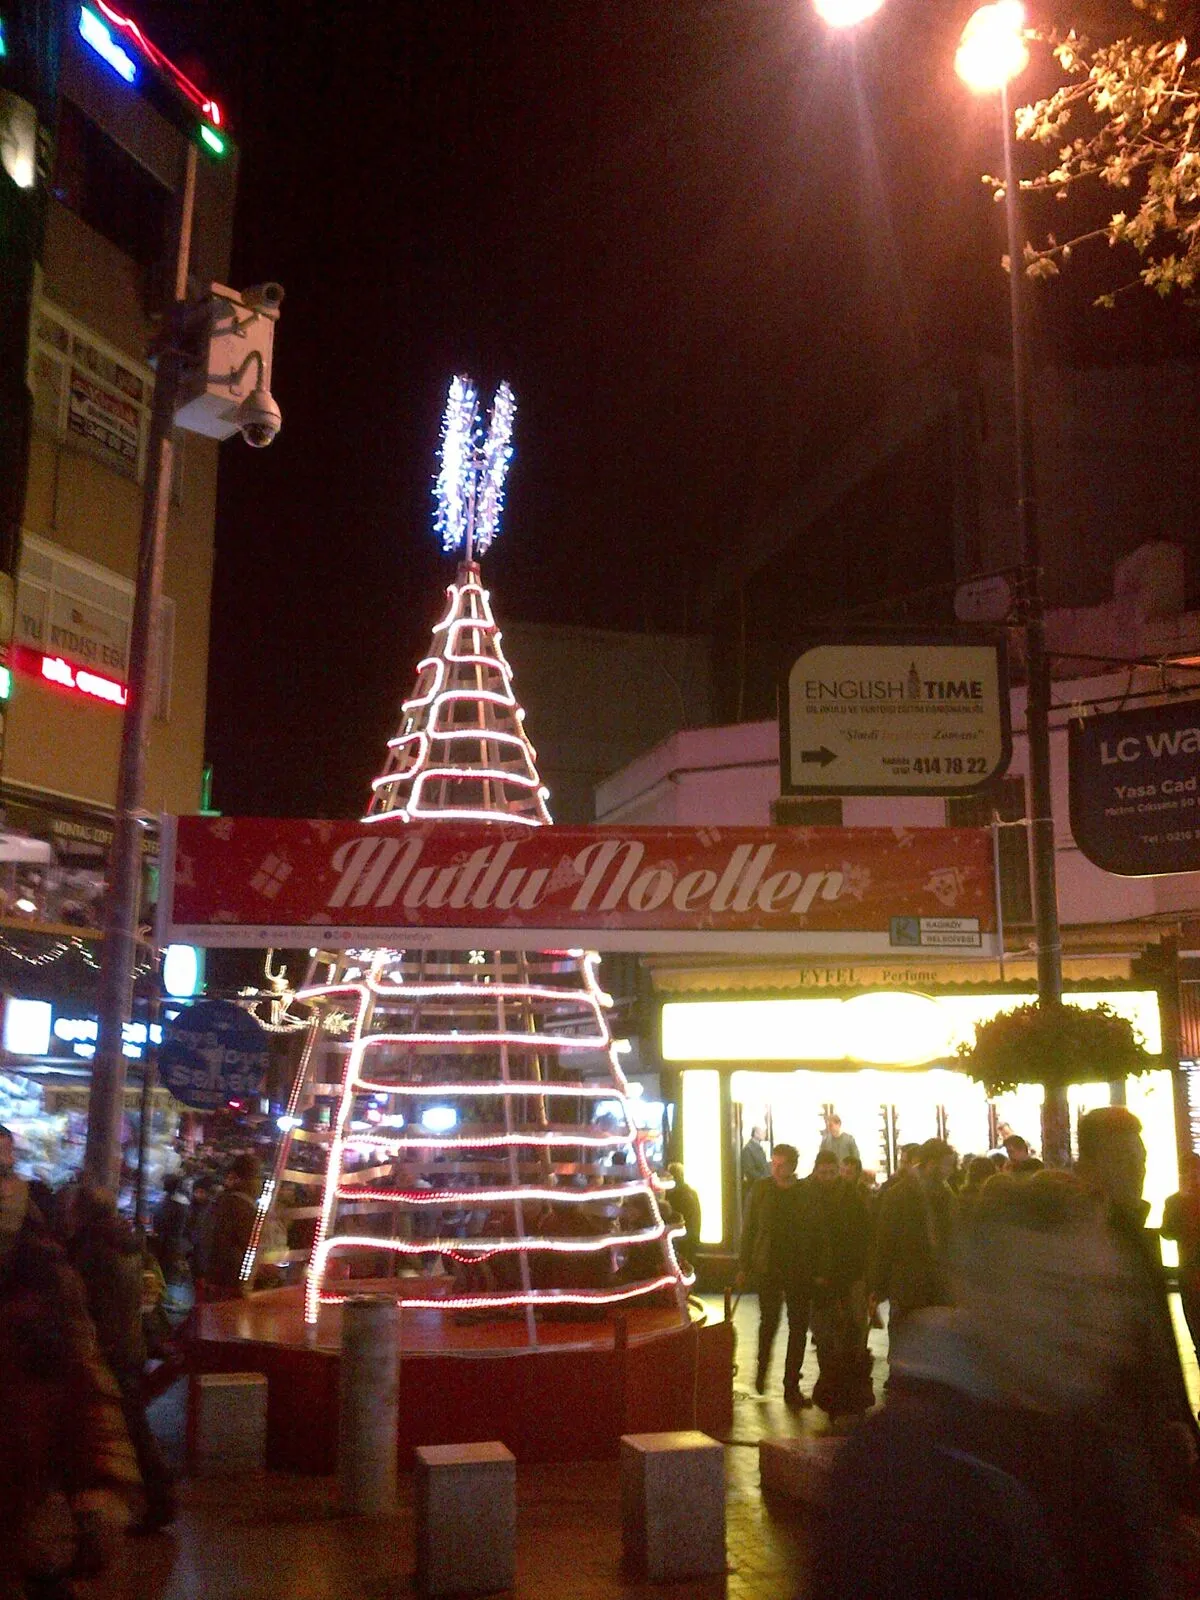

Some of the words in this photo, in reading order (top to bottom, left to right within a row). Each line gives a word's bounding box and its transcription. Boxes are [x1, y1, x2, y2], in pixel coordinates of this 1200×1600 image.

[805, 680, 904, 699] ENGLISH
[924, 681, 983, 699] TIME
[1100, 736, 1141, 765] LC
[913, 757, 941, 774] 414
[945, 757, 963, 774] 78
[967, 757, 987, 774] 22
[1114, 785, 1157, 799] Yasa
[1161, 776, 1197, 794] Cad
[327, 836, 550, 909] Mutlu
[571, 839, 844, 913] Noeller
[882, 969, 938, 982] Perfume
